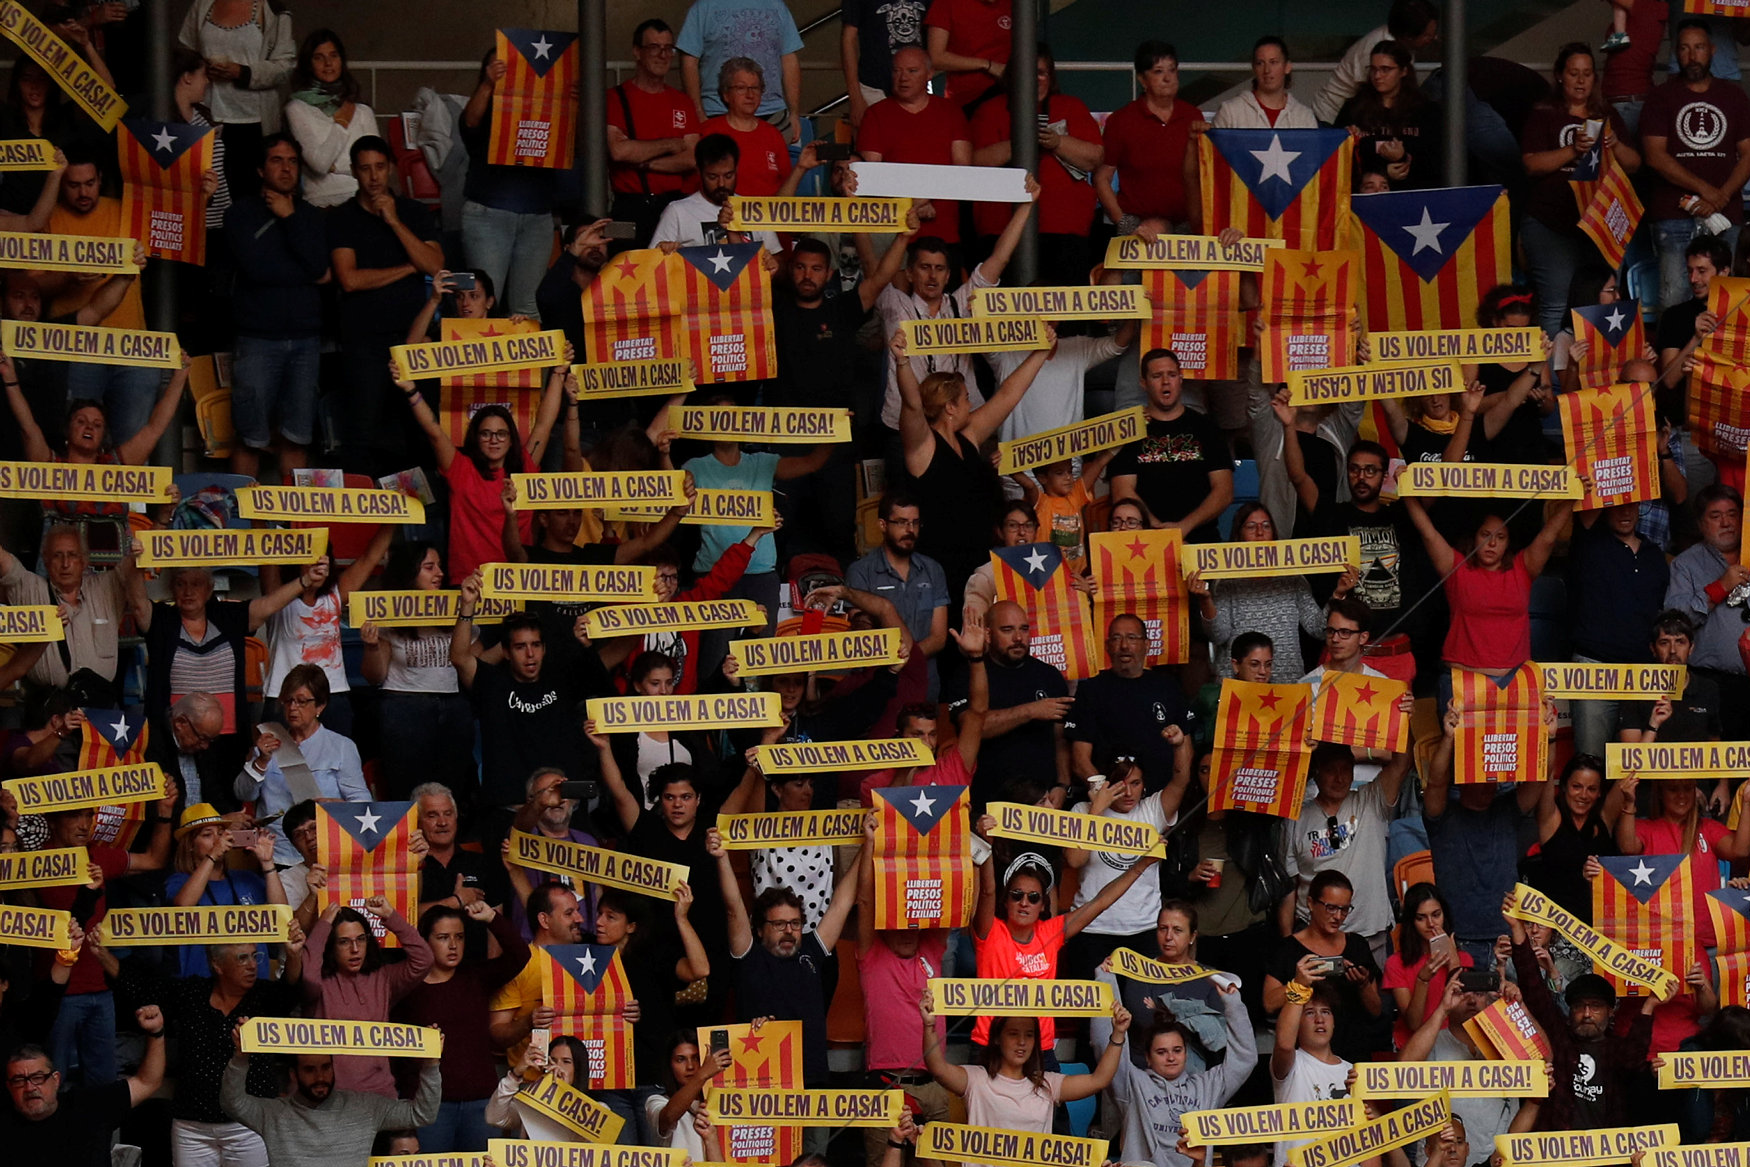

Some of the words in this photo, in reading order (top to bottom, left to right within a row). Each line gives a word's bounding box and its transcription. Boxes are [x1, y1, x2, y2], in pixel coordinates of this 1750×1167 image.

[985, 292, 1007, 313] US
[1010, 291, 1067, 312] VOLEM
[1072, 290, 1083, 311] A
[1087, 289, 1135, 311] CASA!
[710, 334, 744, 344] LLIBERTAT
[711, 343, 745, 354] PRESOS
[717, 363, 746, 372] EXILIATS
[1431, 366, 1452, 389] US
[1303, 375, 1351, 400] CASA!
[1356, 374, 1367, 396] A
[1372, 369, 1427, 394] VOLEM
[151, 535, 174, 558] US
[179, 534, 238, 557] VOLEM
[243, 534, 255, 555] A
[260, 533, 312, 555] CASA!
[907, 880, 942, 888] LLIBERTAT
[907, 889, 941, 899] PRESOS
[110, 913, 135, 936] US
[138, 911, 201, 935] VOLEM
[207, 911, 219, 934] A
[224, 910, 276, 933] CASA!
[1520, 891, 1546, 913] US
[1546, 904, 1600, 949] VOLEM
[1596, 943, 1612, 960] A
[1611, 952, 1664, 985] CASA!
[1366, 1067, 1390, 1090] US
[1394, 1066, 1455, 1089] VOLEM
[1461, 1066, 1473, 1088] A
[1478, 1065, 1531, 1088] CASA!
